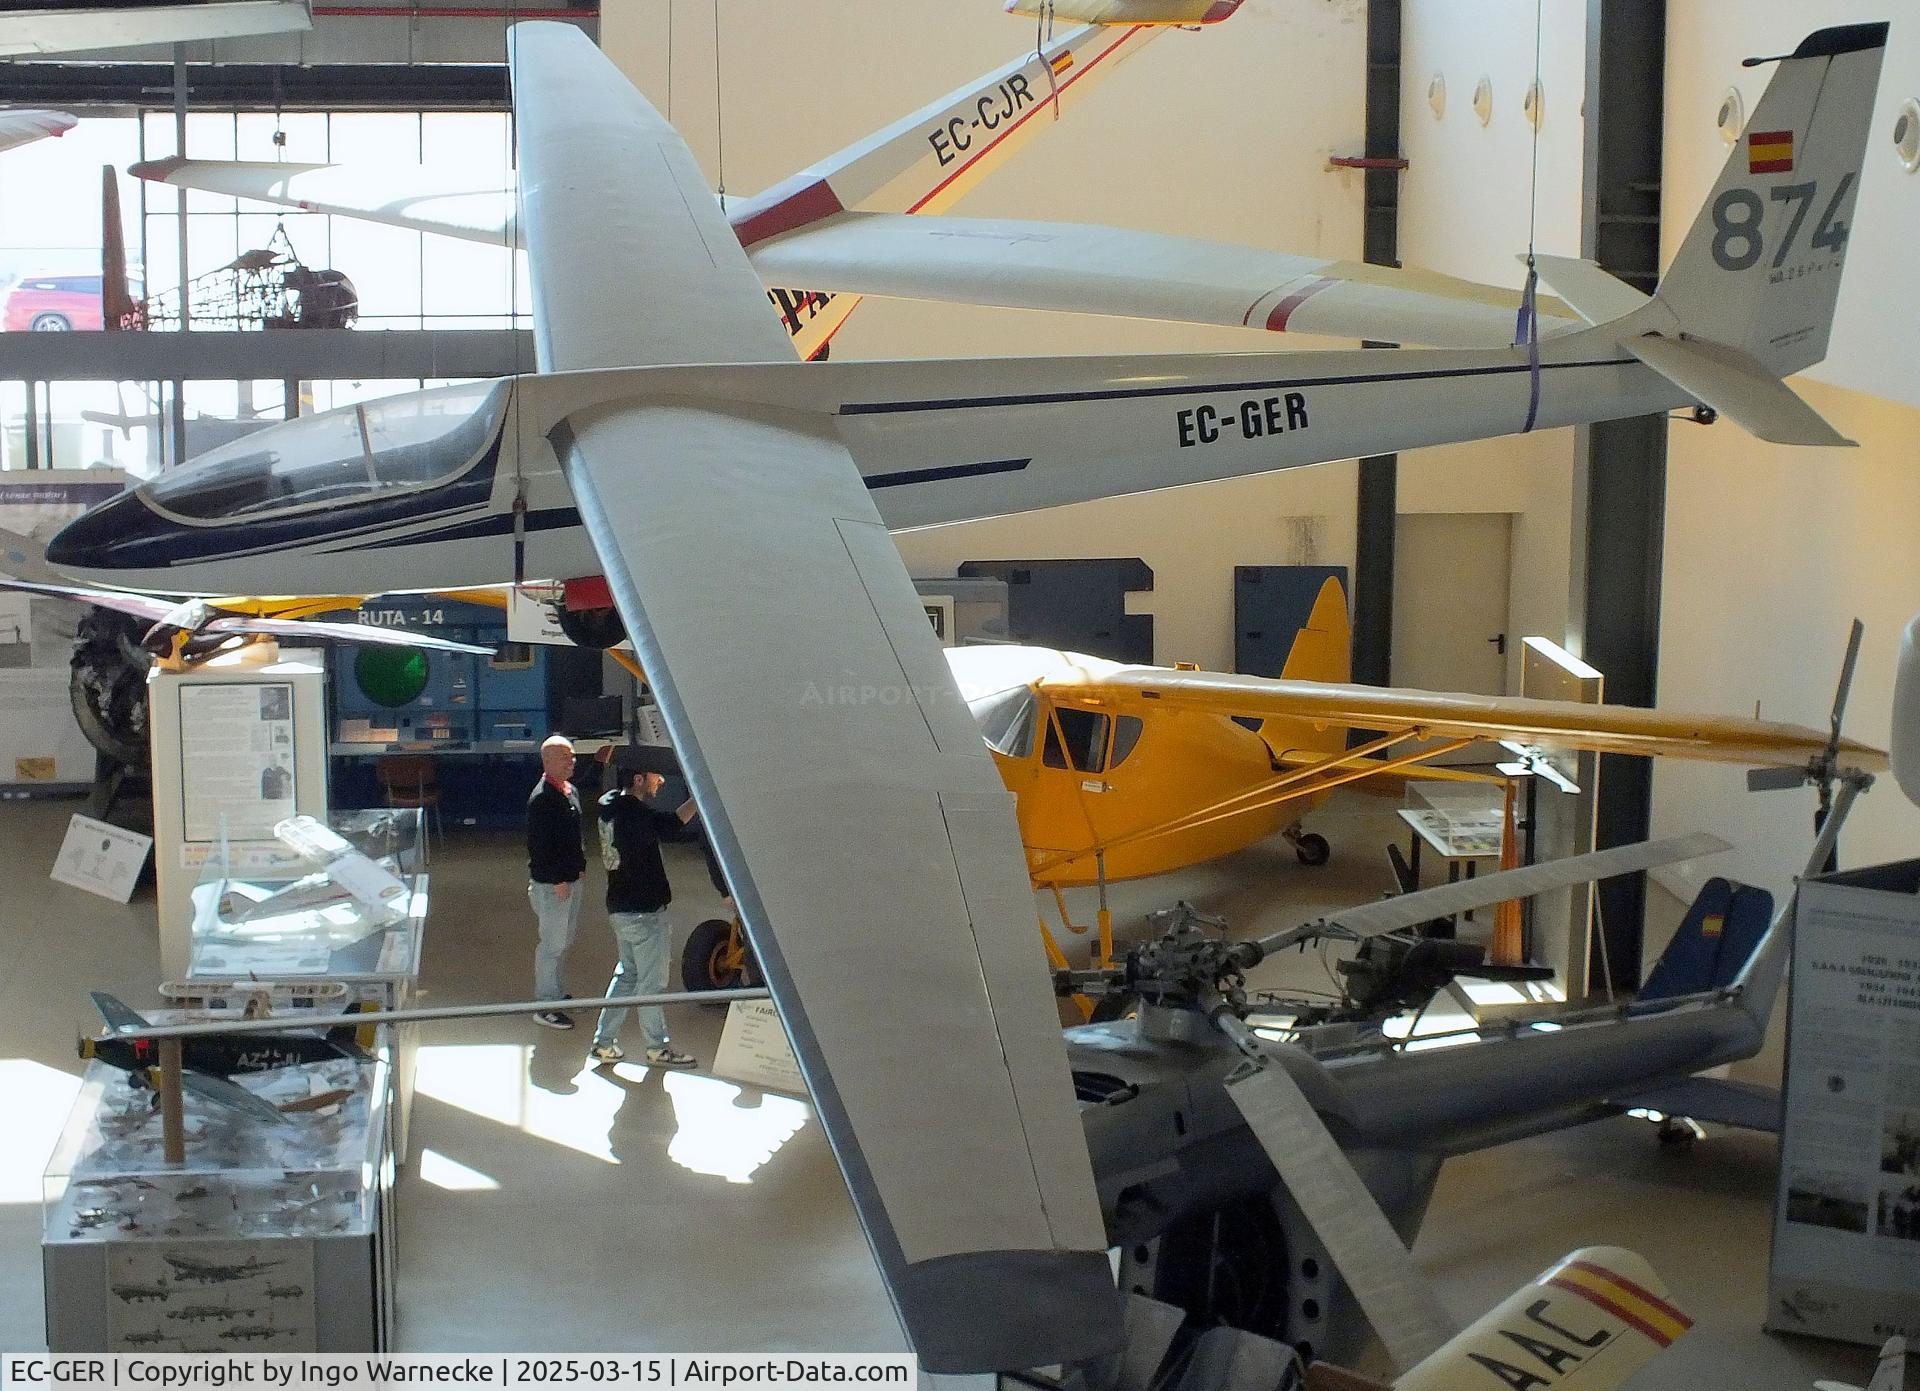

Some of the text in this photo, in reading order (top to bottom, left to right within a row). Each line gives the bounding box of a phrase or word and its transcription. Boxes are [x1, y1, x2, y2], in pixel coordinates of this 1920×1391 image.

[928, 73, 1034, 167] EC-CJR
[1712, 171, 1856, 271] 874
[1177, 392, 1309, 448] EC-GER
[358, 609, 406, 626] RUTA
[422, 608, 444, 625] 14
